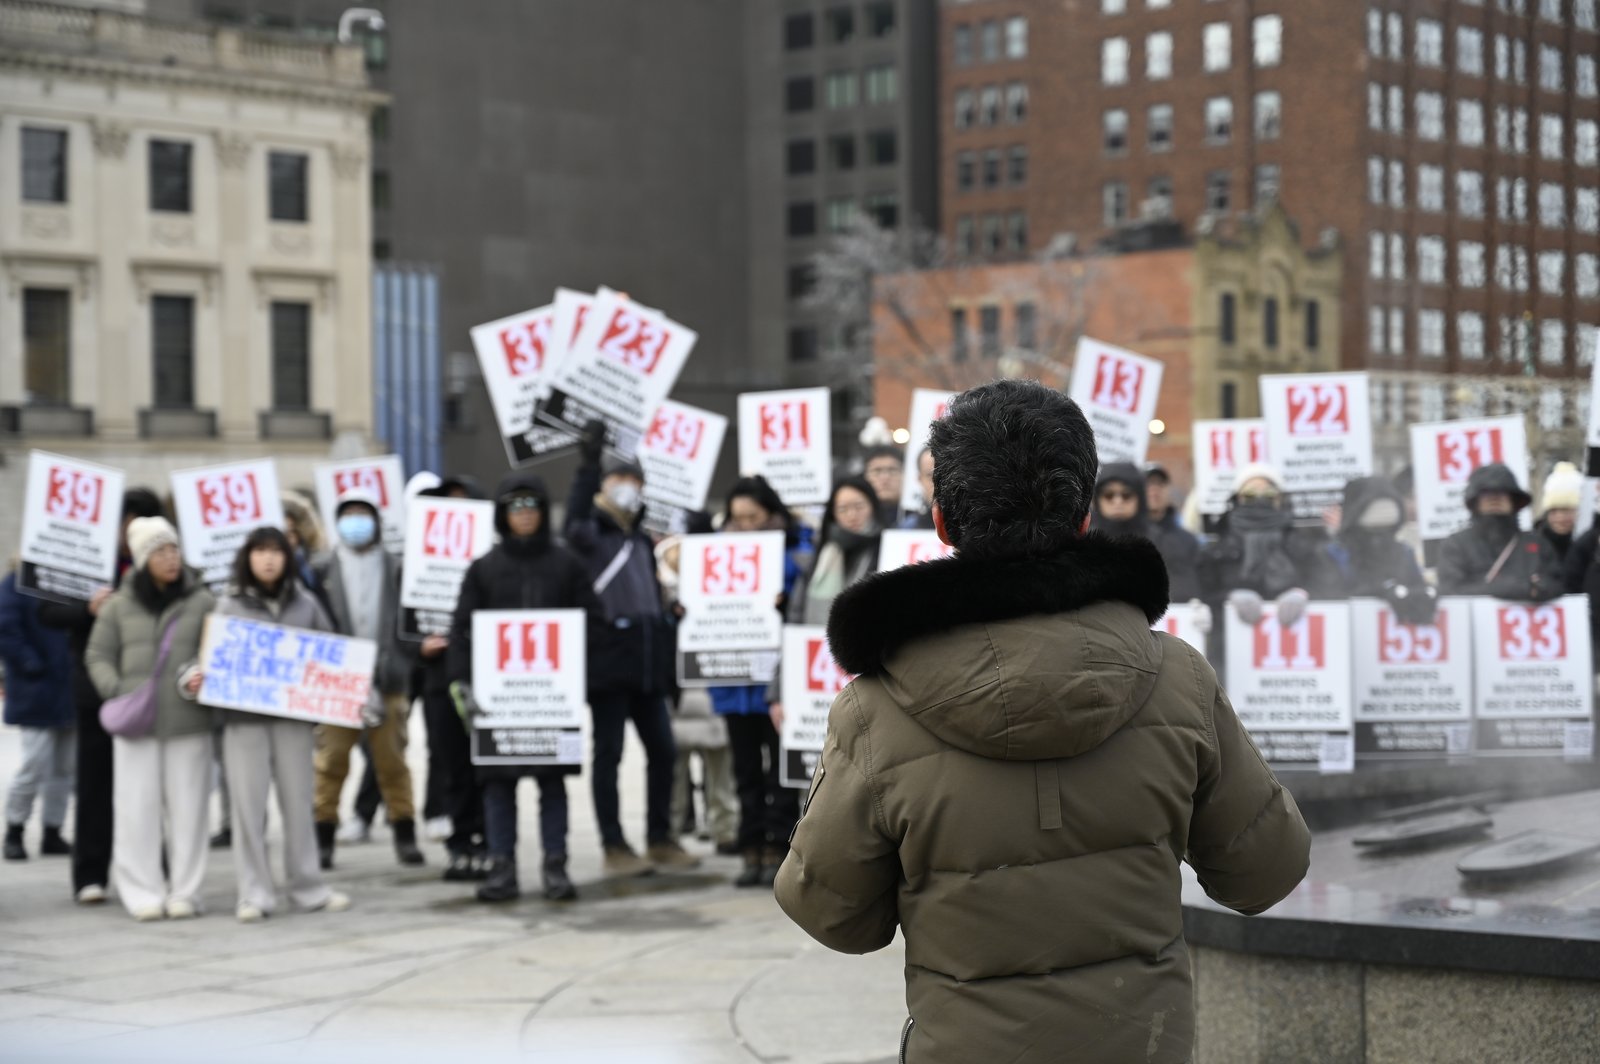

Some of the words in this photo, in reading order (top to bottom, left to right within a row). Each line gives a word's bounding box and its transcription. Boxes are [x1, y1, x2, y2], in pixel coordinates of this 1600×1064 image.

[602, 310, 664, 372] 23
[1094, 357, 1139, 411] 13
[762, 402, 809, 450] 31
[1291, 386, 1346, 434] 22
[1441, 430, 1493, 480] 31
[49, 469, 100, 522] 39
[203, 472, 258, 523] 39
[424, 510, 472, 560] 40
[706, 545, 757, 592] 35
[226, 617, 284, 658] STOP
[297, 634, 346, 665] THE
[503, 622, 553, 671] 11
[1261, 614, 1316, 669] 11
[1386, 611, 1442, 660] 55
[1504, 605, 1560, 657] 33
